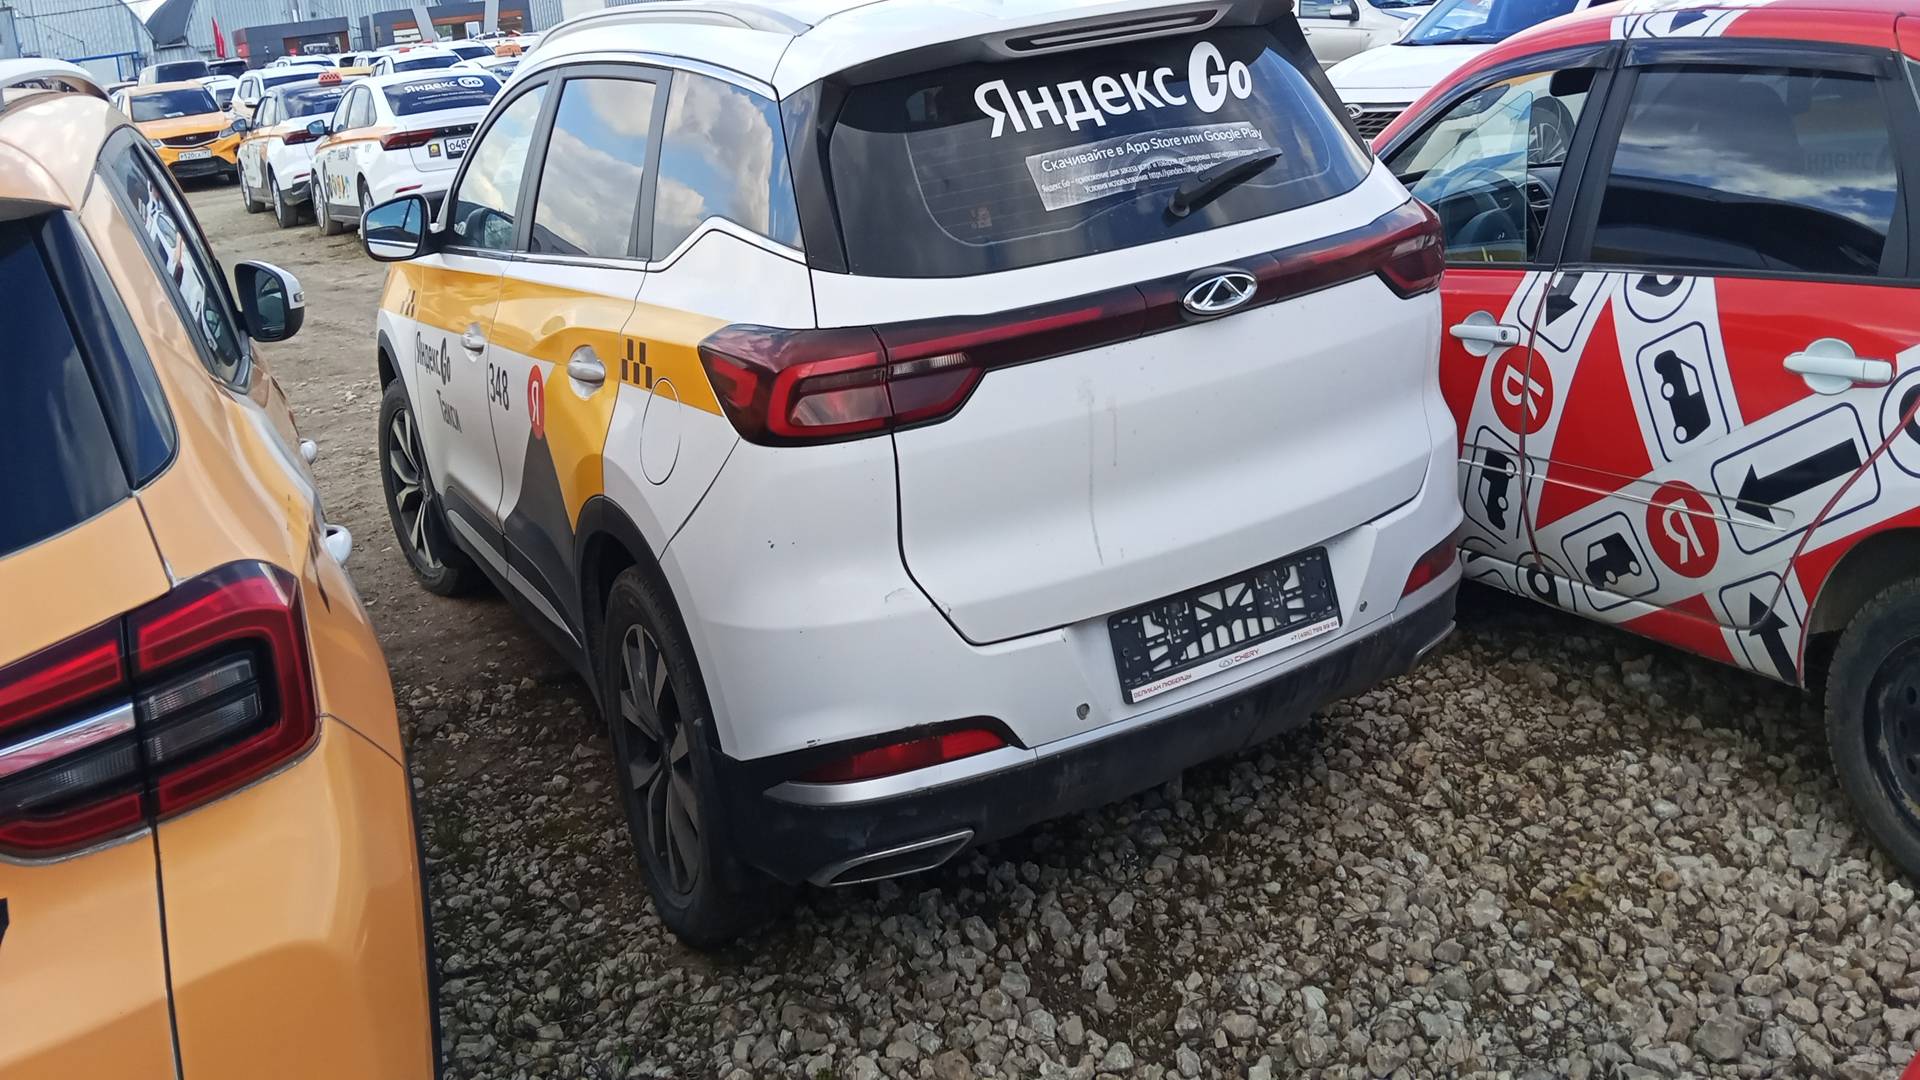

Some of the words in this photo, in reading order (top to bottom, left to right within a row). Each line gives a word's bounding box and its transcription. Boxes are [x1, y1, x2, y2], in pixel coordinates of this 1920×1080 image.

[404, 80, 457, 93] Яндекс
[974, 66, 1187, 139] Яндекс
[1188, 41, 1253, 113] Go
[1041, 148, 1115, 172] Скачивайте
[1115, 147, 1124, 155] в
[1126, 142, 1150, 155] App
[1150, 135, 1181, 149] Store
[1182, 133, 1204, 145] или
[1204, 129, 1242, 142] Google
[1241, 127, 1263, 140] Play
[416, 331, 441, 376] Яндекс
[440, 337, 452, 386] Go
[488, 362, 510, 411] 348
[437, 390, 463, 433] Такси
[1232, 649, 1260, 663] CHERY
